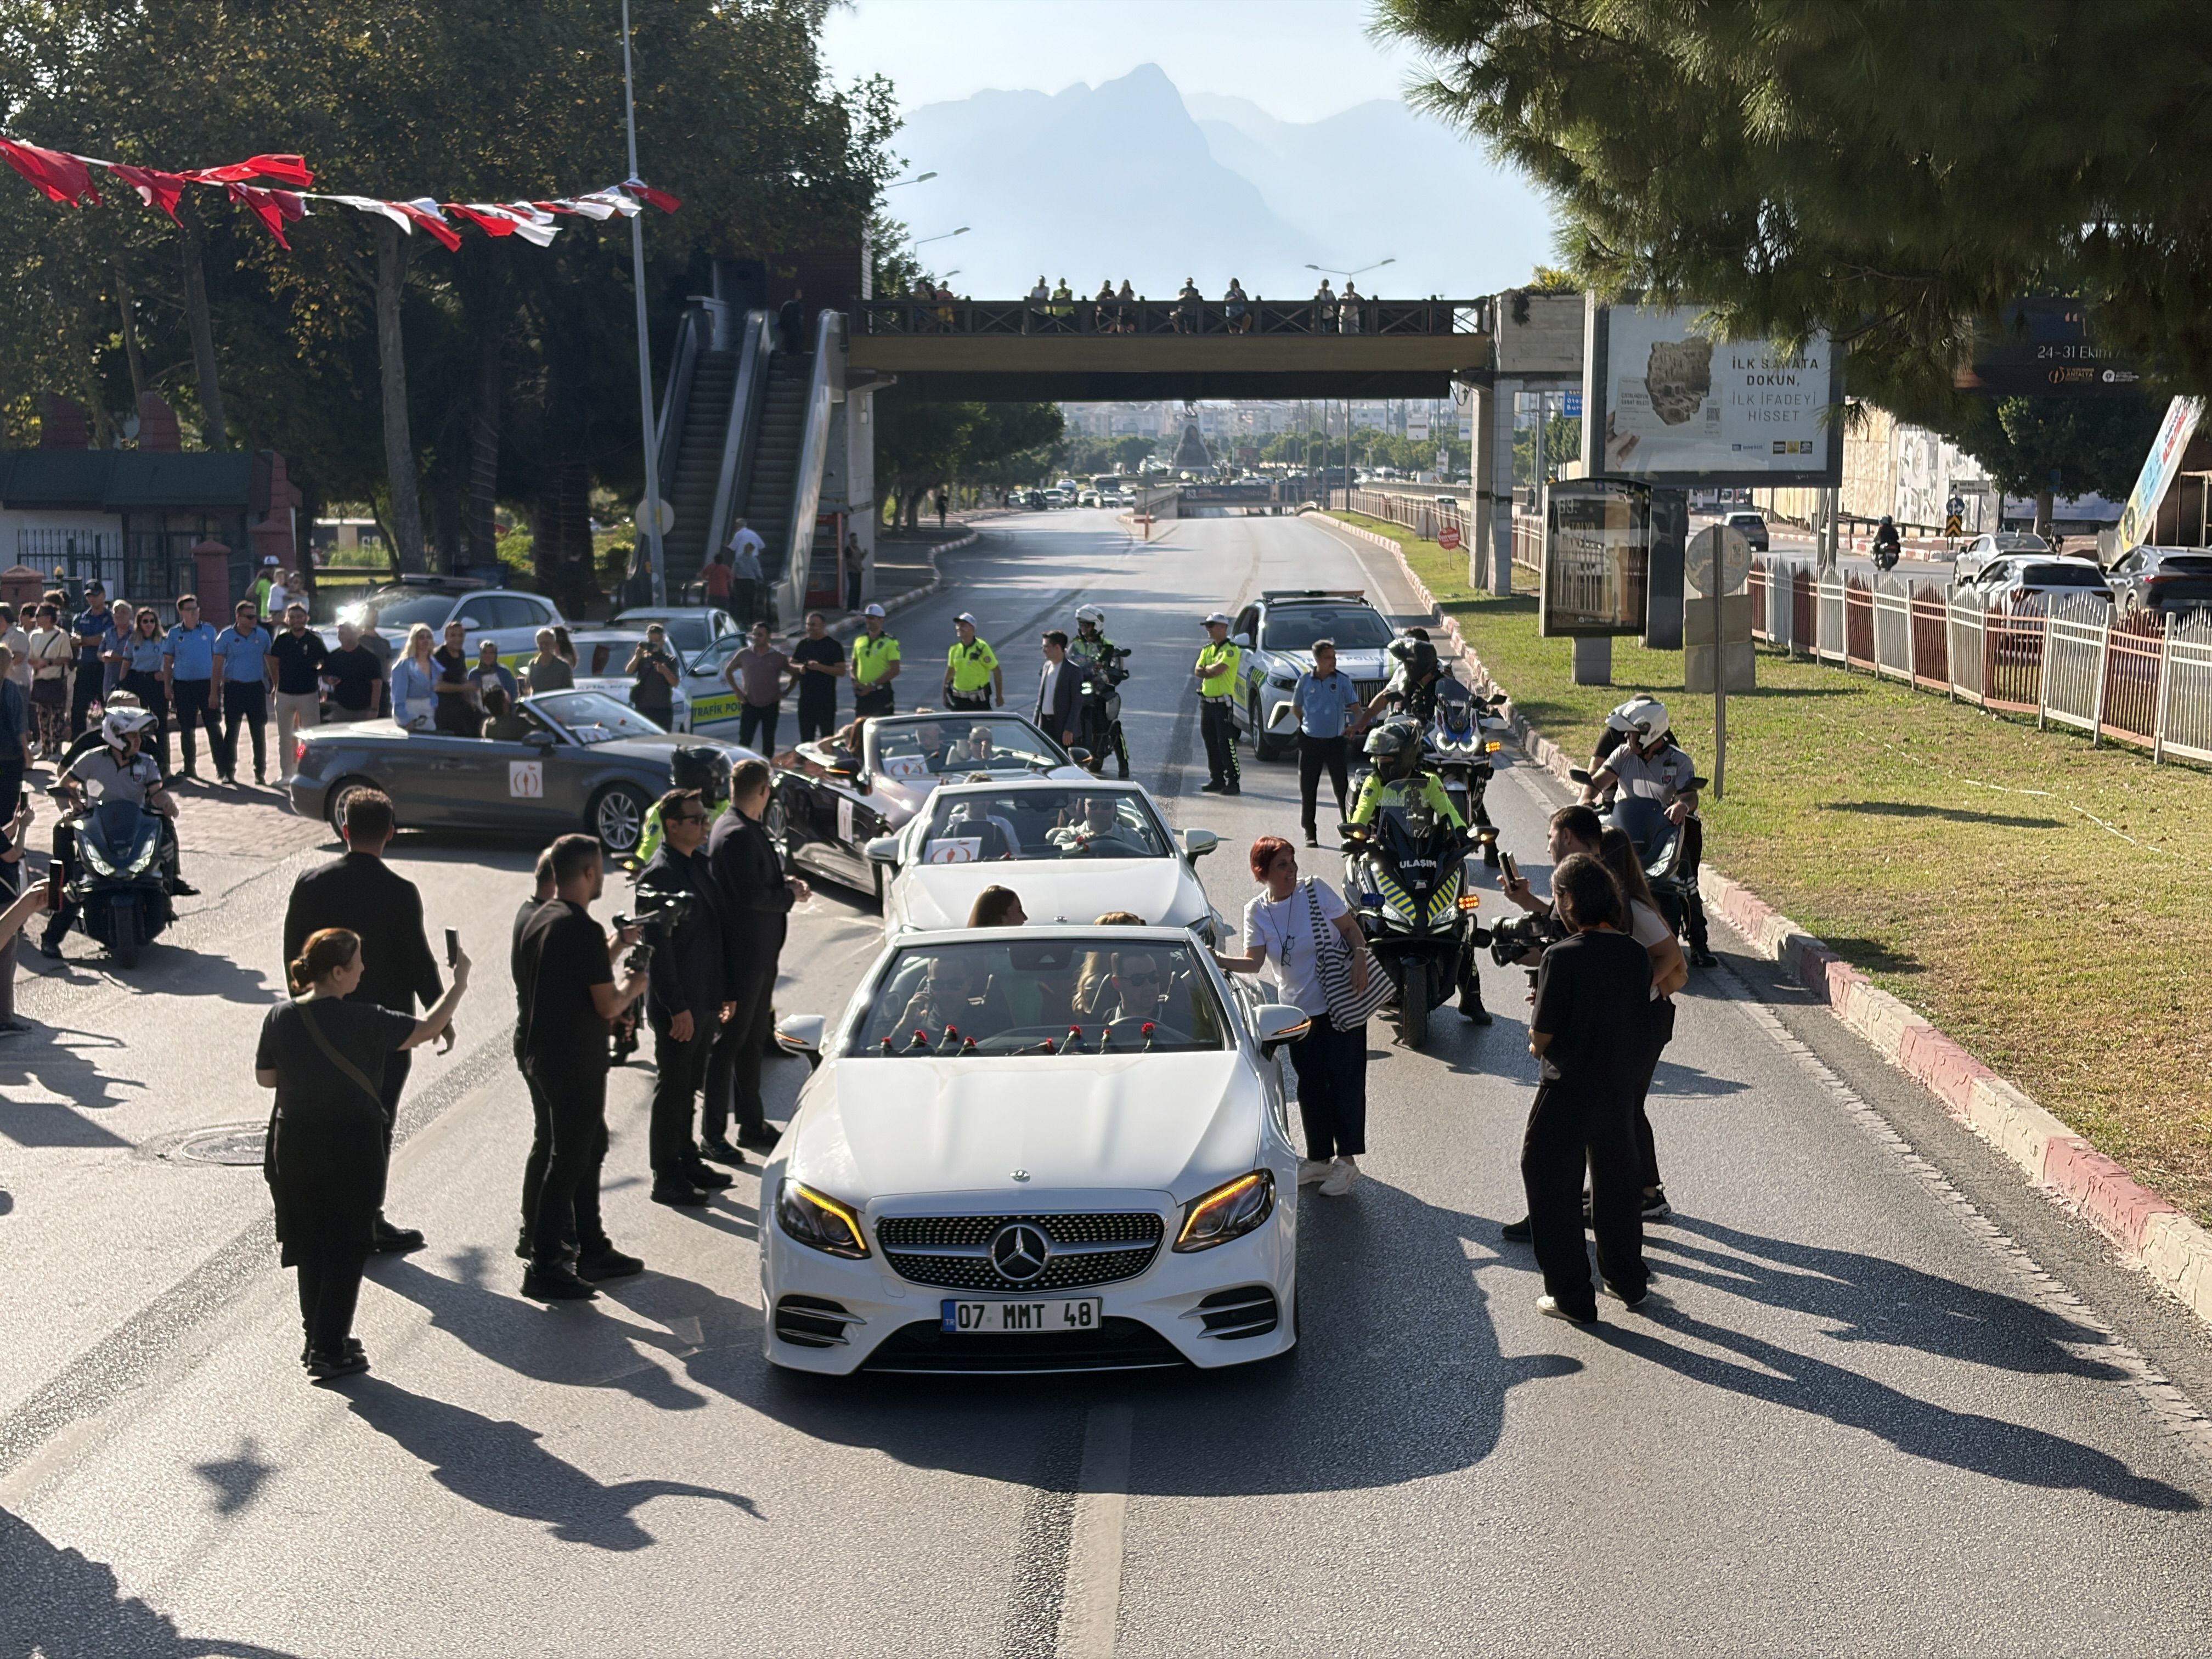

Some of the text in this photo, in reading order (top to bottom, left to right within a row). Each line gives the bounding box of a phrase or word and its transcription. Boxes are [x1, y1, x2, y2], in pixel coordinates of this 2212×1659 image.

[1733, 357, 1755, 369] İLK
[1747, 375, 1800, 387] DOKUN,
[1733, 392, 1816, 405] İLK İFADEYİ
[1748, 408, 1799, 421] HİSSET
[692, 702, 723, 717] TRAFİK
[1400, 859, 1437, 869] ULAŞIM
[958, 1302, 1091, 1329] 07 MMT 48
